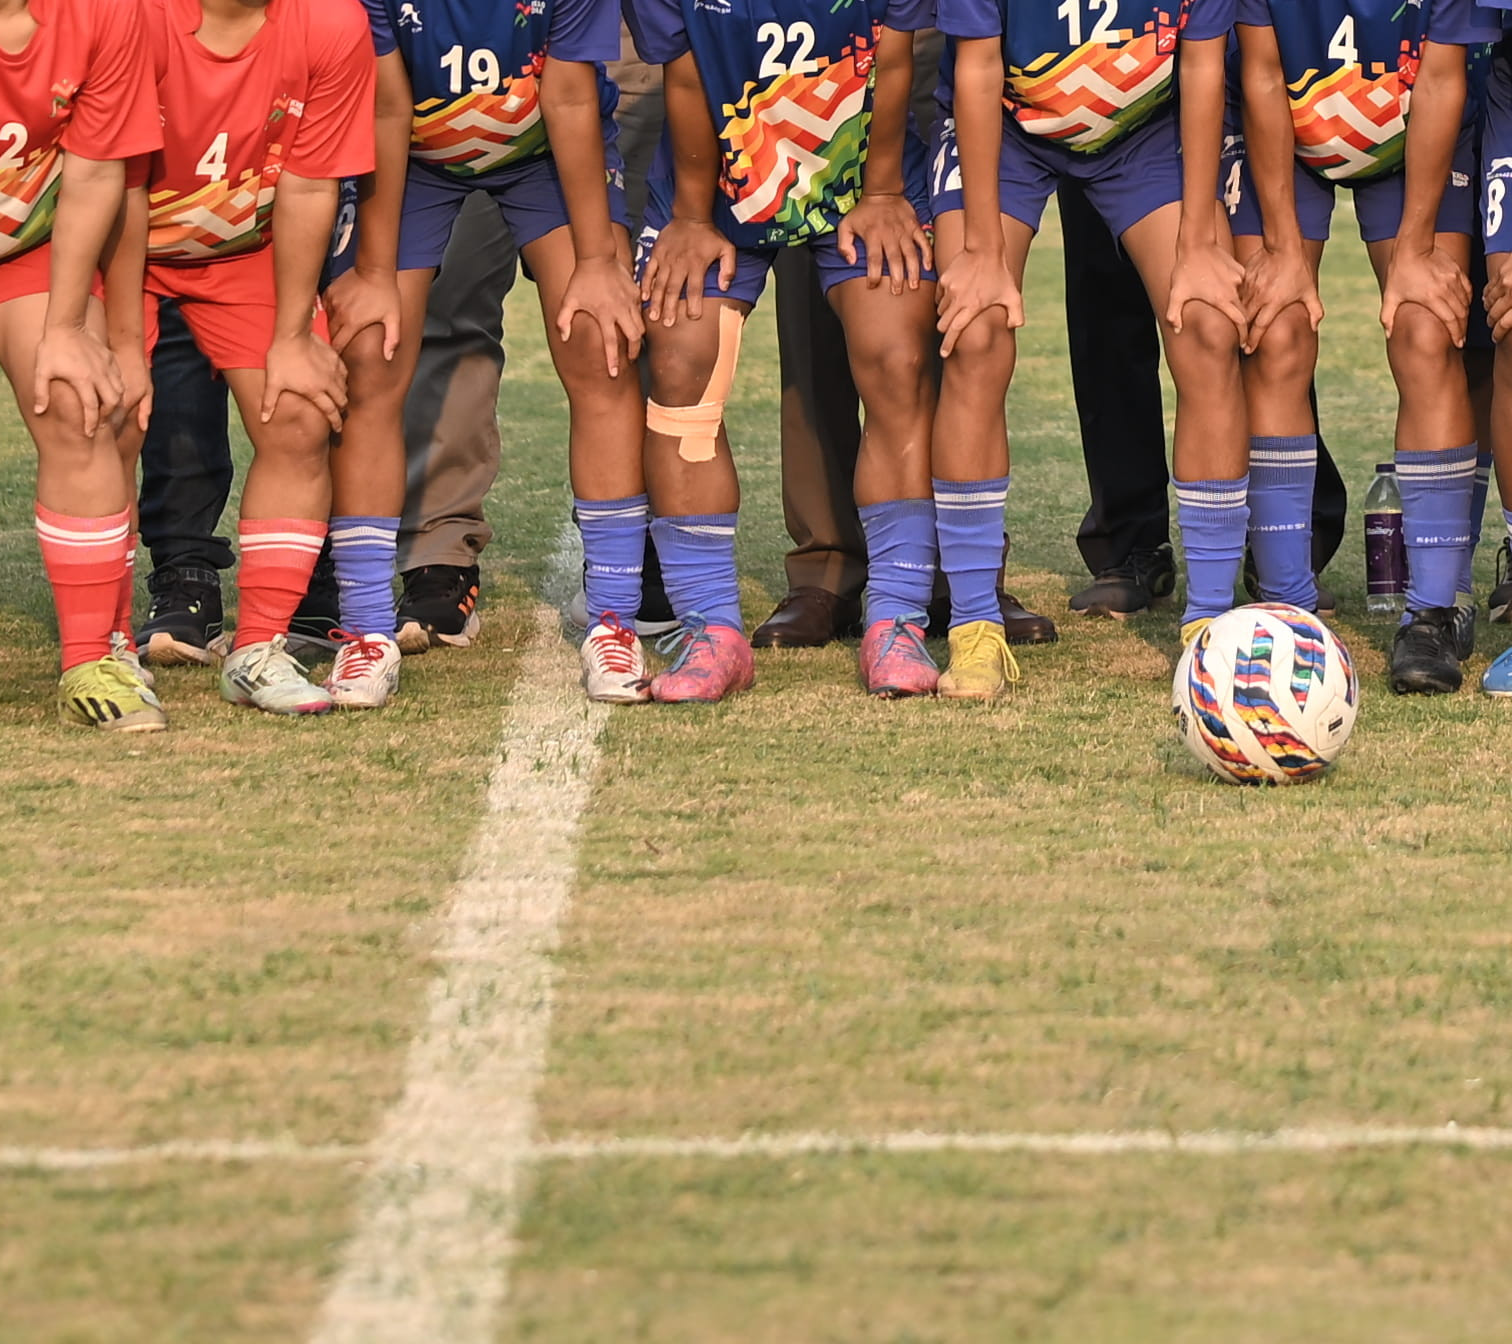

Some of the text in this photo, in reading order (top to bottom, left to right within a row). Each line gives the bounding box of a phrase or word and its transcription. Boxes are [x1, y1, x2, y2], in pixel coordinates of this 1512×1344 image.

[439, 44, 500, 96] 19
[758, 21, 817, 79] 22
[1327, 14, 1358, 70] 4
[195, 132, 227, 181] 4
[1223, 159, 1242, 216] 4
[1486, 179, 1506, 237] 8
